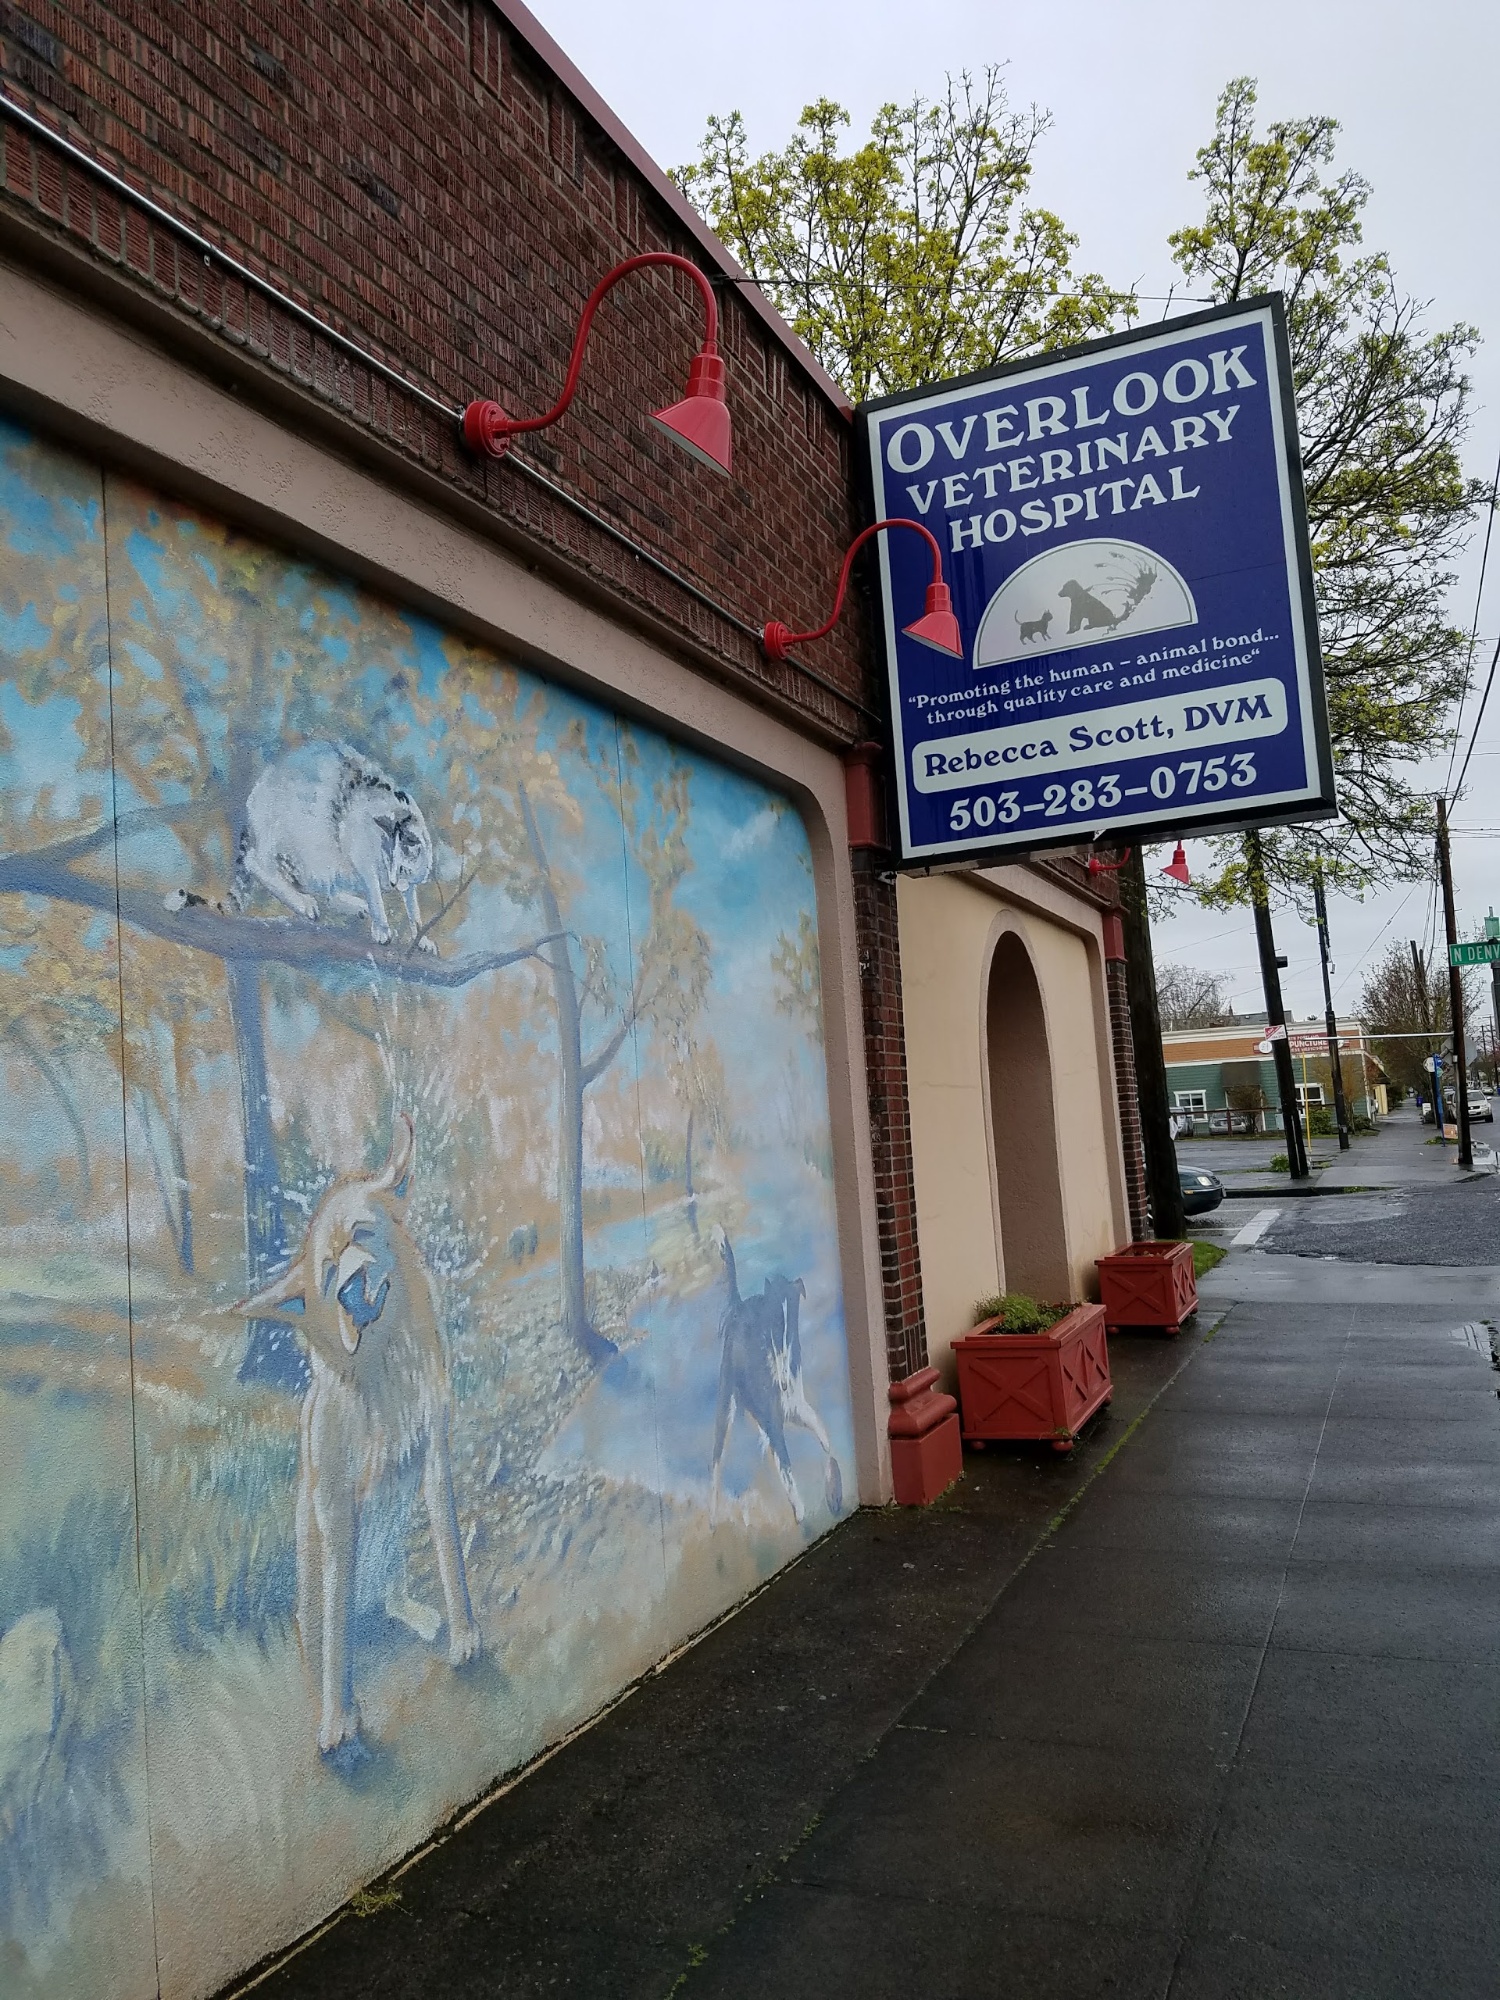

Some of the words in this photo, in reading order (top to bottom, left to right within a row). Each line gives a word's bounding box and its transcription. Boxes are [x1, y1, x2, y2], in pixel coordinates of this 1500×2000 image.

[887, 345, 1257, 474] OVERLOOK
[906, 405, 1241, 515] VETERINARY
[949, 466, 1201, 553] HOSPITAL
[926, 700, 999, 725] through
[1003, 688, 1067, 712] quality
[1070, 679, 1115, 697] care
[1119, 668, 1156, 688] and
[1015, 674, 1044, 690] the
[1049, 661, 1114, 683] human
[1136, 639, 1208, 666] animal
[1212, 628, 1280, 651] bond...
[924, 740, 1058, 778] Rebecca
[1069, 715, 1175, 754] Scott,
[1184, 694, 1273, 733] DVM
[949, 752, 1258, 832] 503-283-0753
[1454, 947, 1462, 962] N
[1467, 944, 1500, 961] DENV
